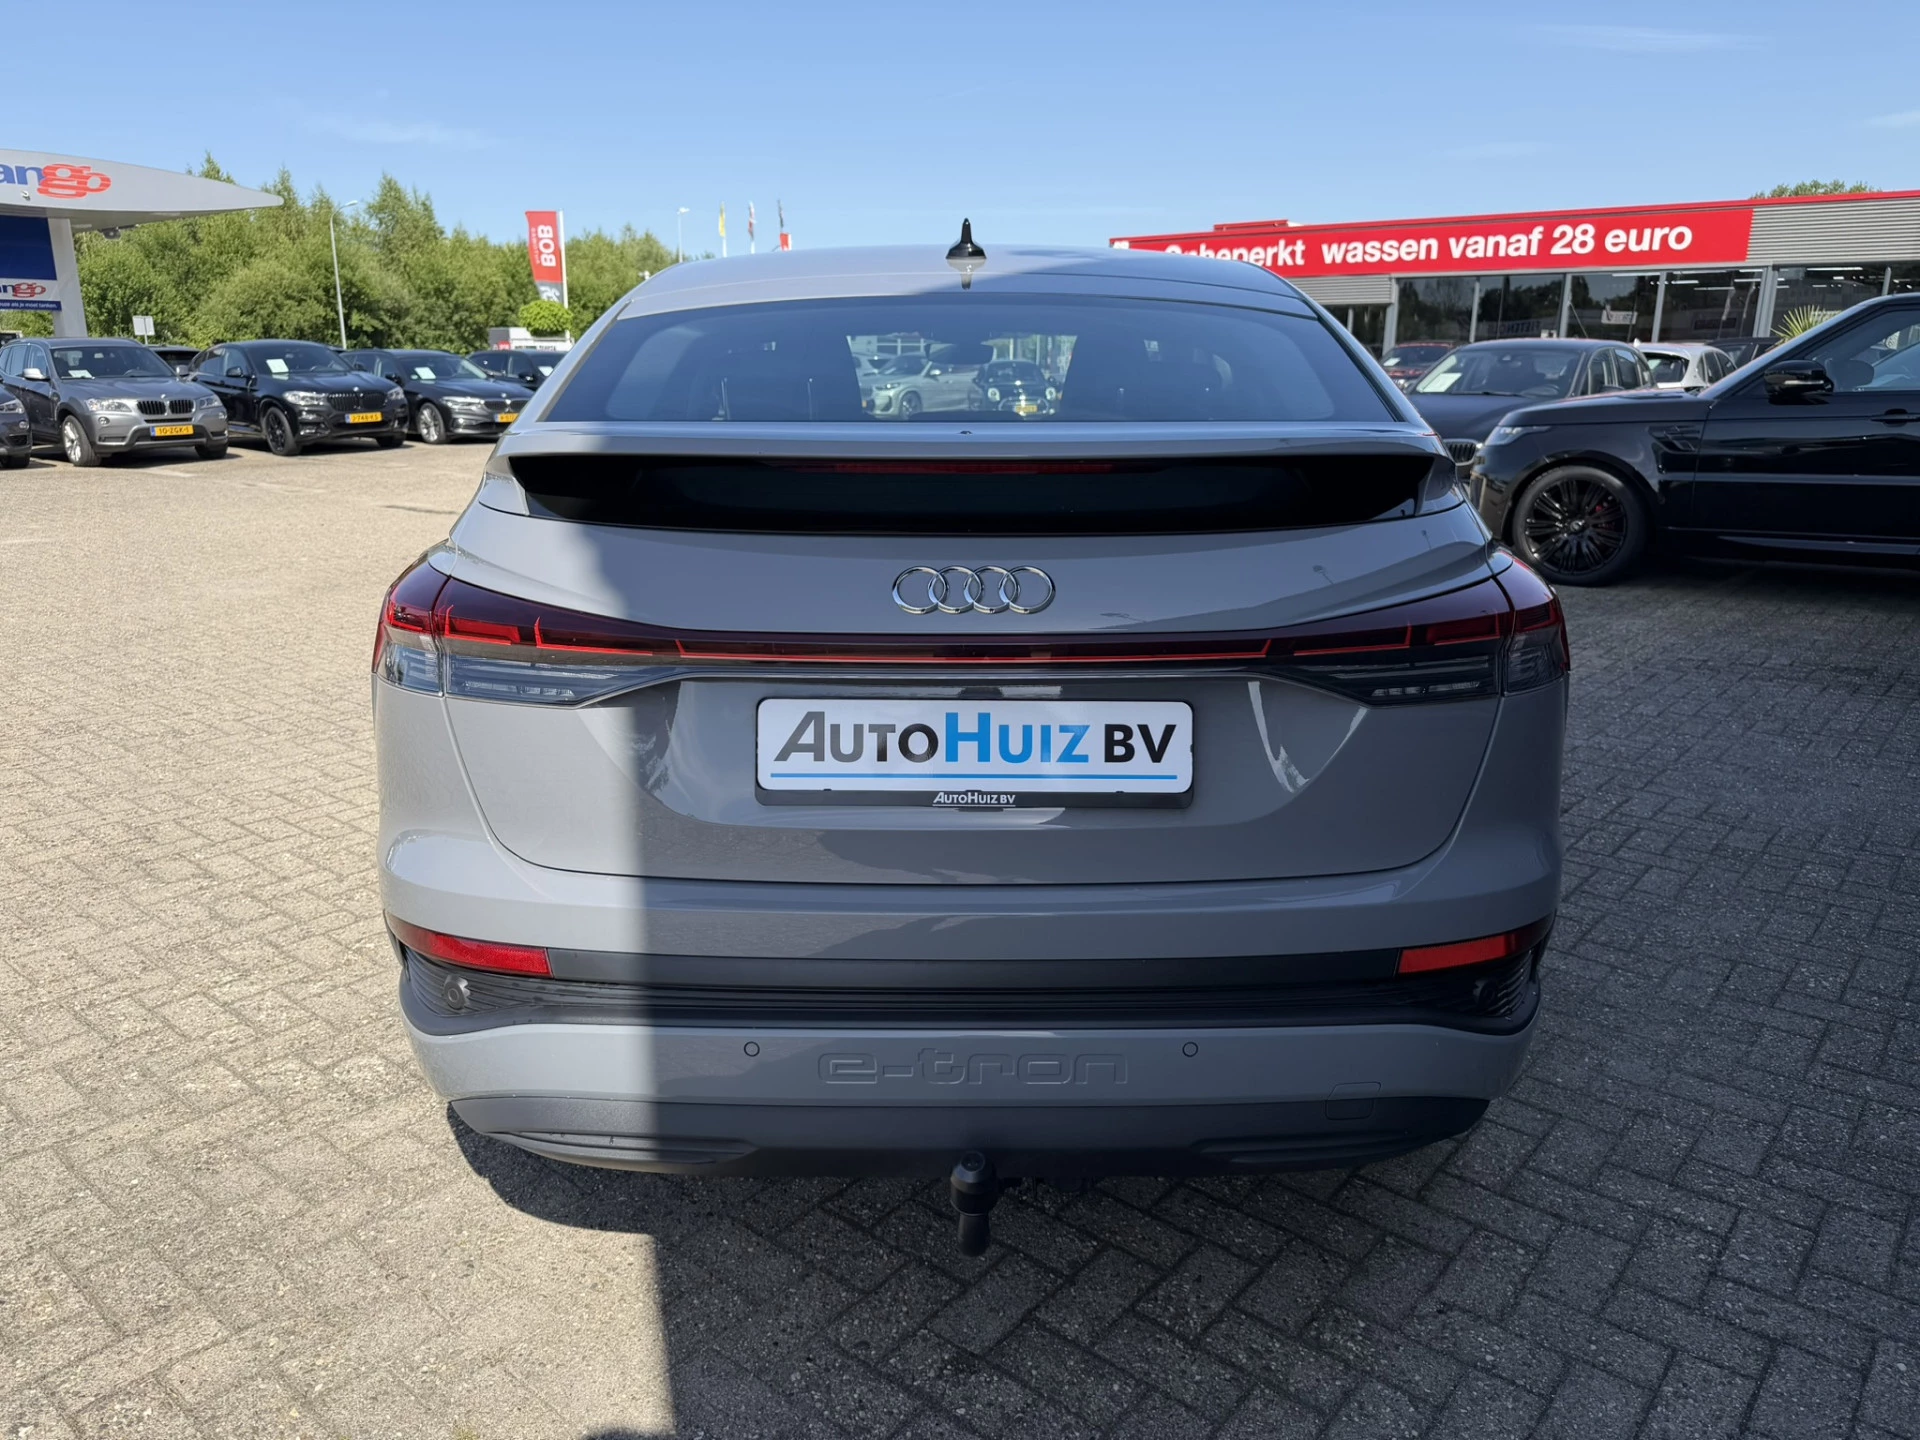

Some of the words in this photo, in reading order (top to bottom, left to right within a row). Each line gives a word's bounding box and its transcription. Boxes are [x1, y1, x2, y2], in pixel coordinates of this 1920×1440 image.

[1321, 235, 1438, 264] wassen
[1449, 226, 1542, 259] vanaf
[1550, 223, 1596, 255] 28
[1604, 225, 1693, 253] euro
[0, 283, 47, 298] ngo
[774, 711, 1089, 763] AUTOHUIZ
[1103, 724, 1177, 764] BV
[1000, 794, 1016, 804] BV
[818, 1048, 1128, 1085] e-tron
